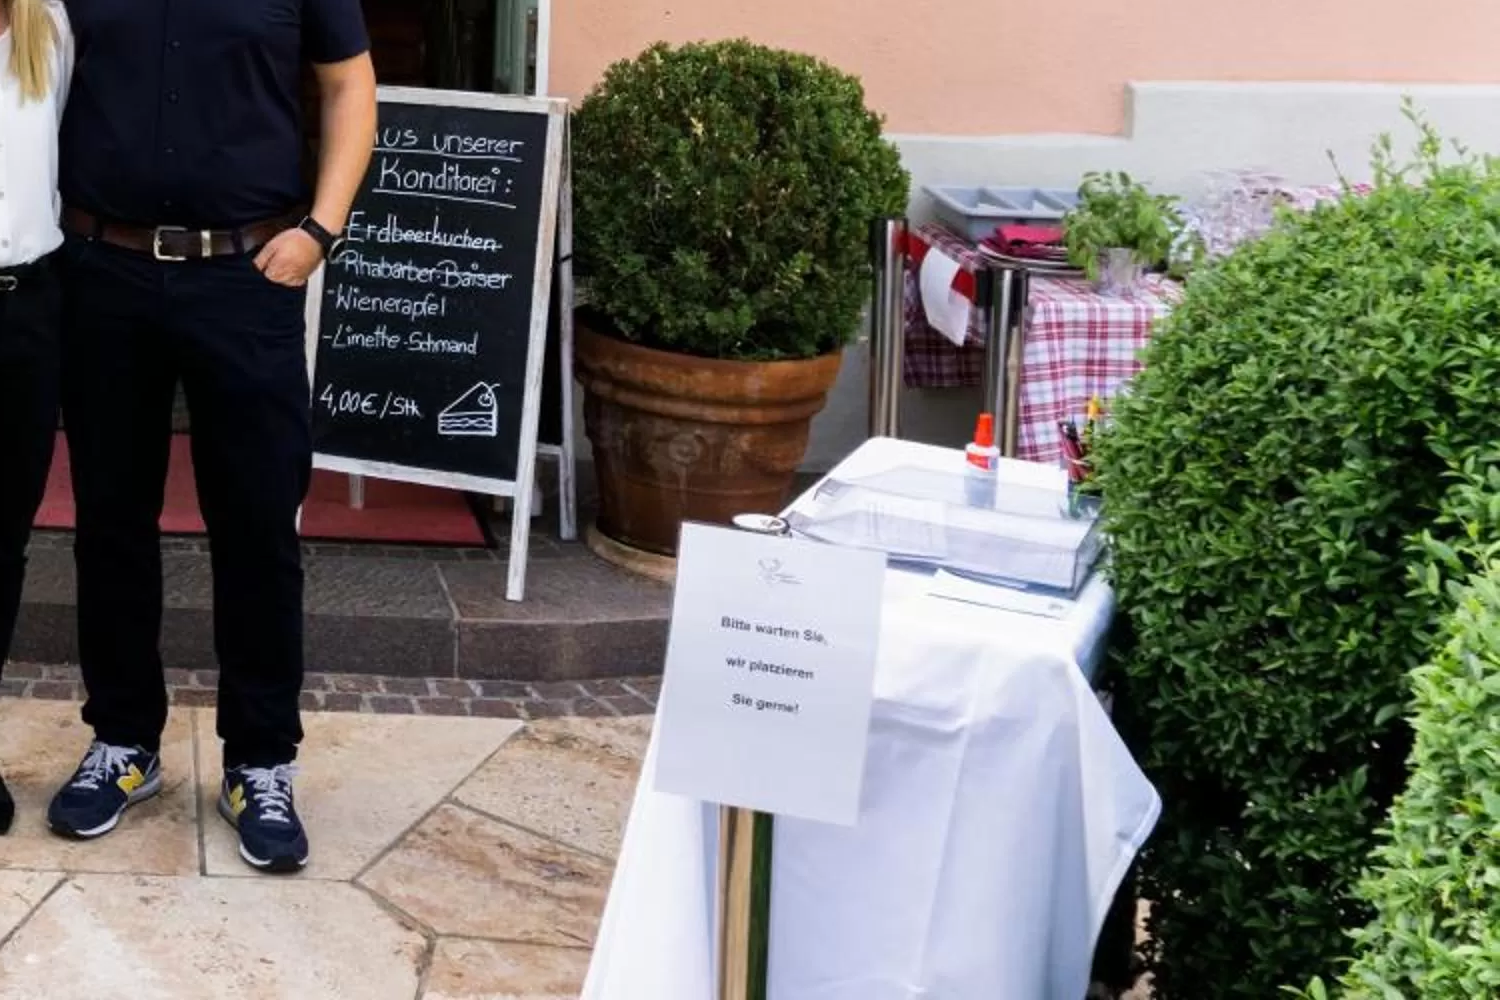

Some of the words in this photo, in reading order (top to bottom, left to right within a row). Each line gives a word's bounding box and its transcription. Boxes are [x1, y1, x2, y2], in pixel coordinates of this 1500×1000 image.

[375, 127, 418, 147] us
[432, 134, 524, 154] unserer
[721, 616, 751, 631] Bitte
[755, 625, 799, 639] warten
[726, 657, 746, 667] wir
[749, 660, 814, 679] platzieren
[732, 693, 753, 706] Sie
[756, 700, 799, 713] gerne!
